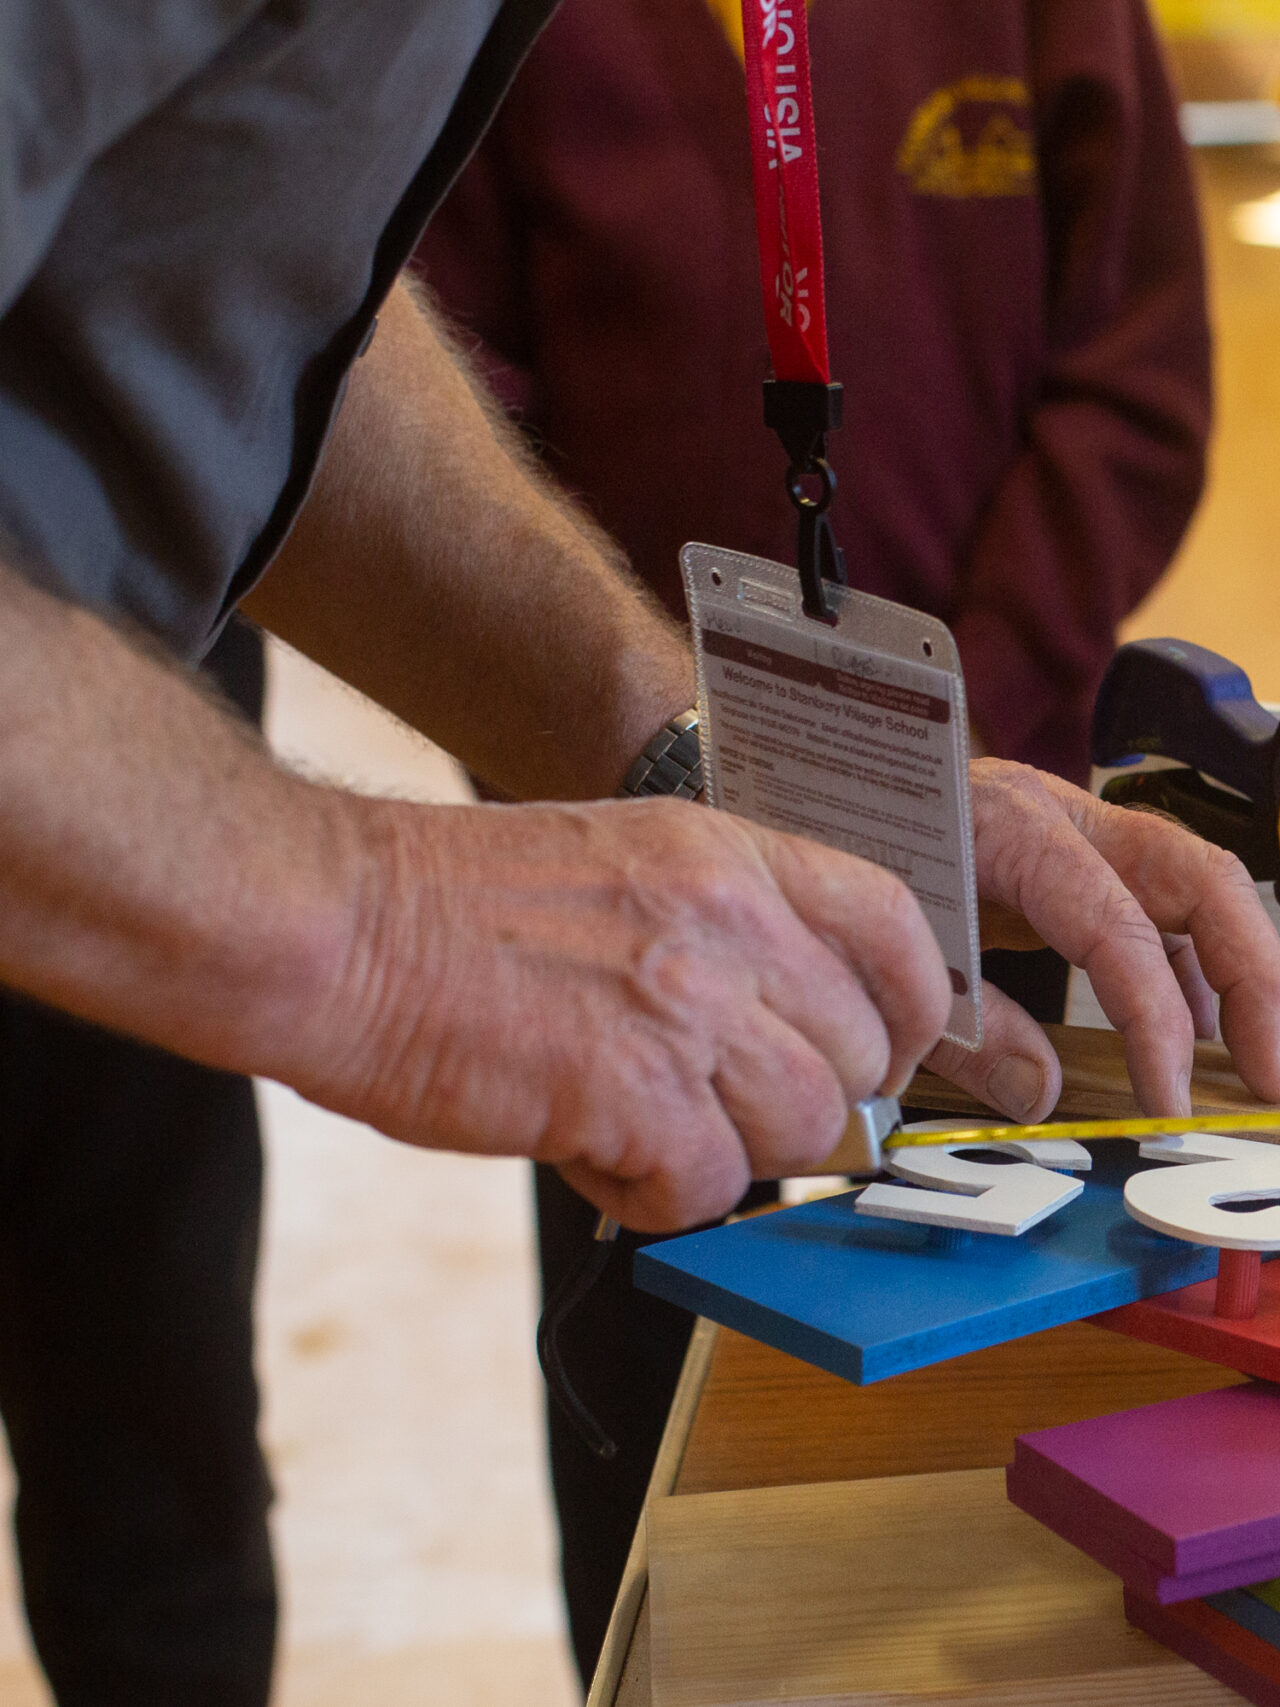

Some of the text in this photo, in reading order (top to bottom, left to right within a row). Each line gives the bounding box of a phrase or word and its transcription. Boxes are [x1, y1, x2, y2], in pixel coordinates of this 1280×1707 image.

[722, 665, 773, 694] Welcome
[775, 683, 787, 698] to
[842, 703, 882, 729] Village
[884, 716, 929, 740] School
